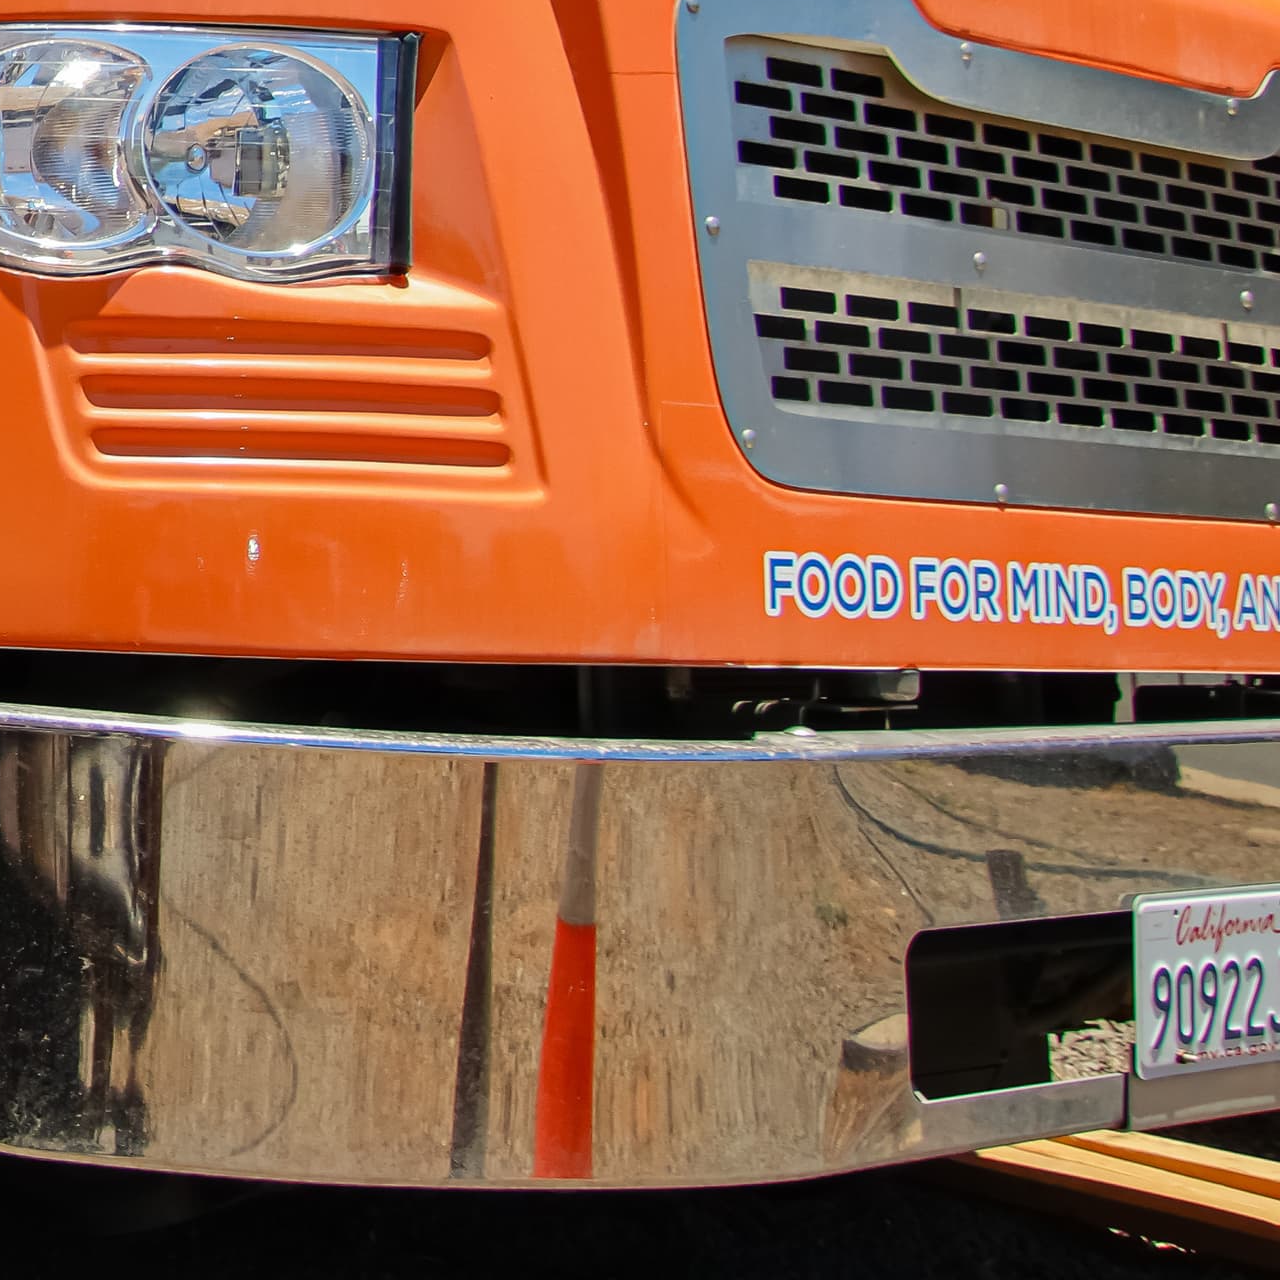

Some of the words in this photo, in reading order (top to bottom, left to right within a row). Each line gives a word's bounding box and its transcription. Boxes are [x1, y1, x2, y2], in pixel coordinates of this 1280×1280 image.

[765, 551, 902, 618] FOOD
[911, 557, 1001, 621] FOR
[1007, 562, 1117, 634] MIND,
[1123, 567, 1228, 637] BODY,
[1176, 904, 1280, 953] California
[1184, 1042, 1277, 1062] mv.ca.gov
